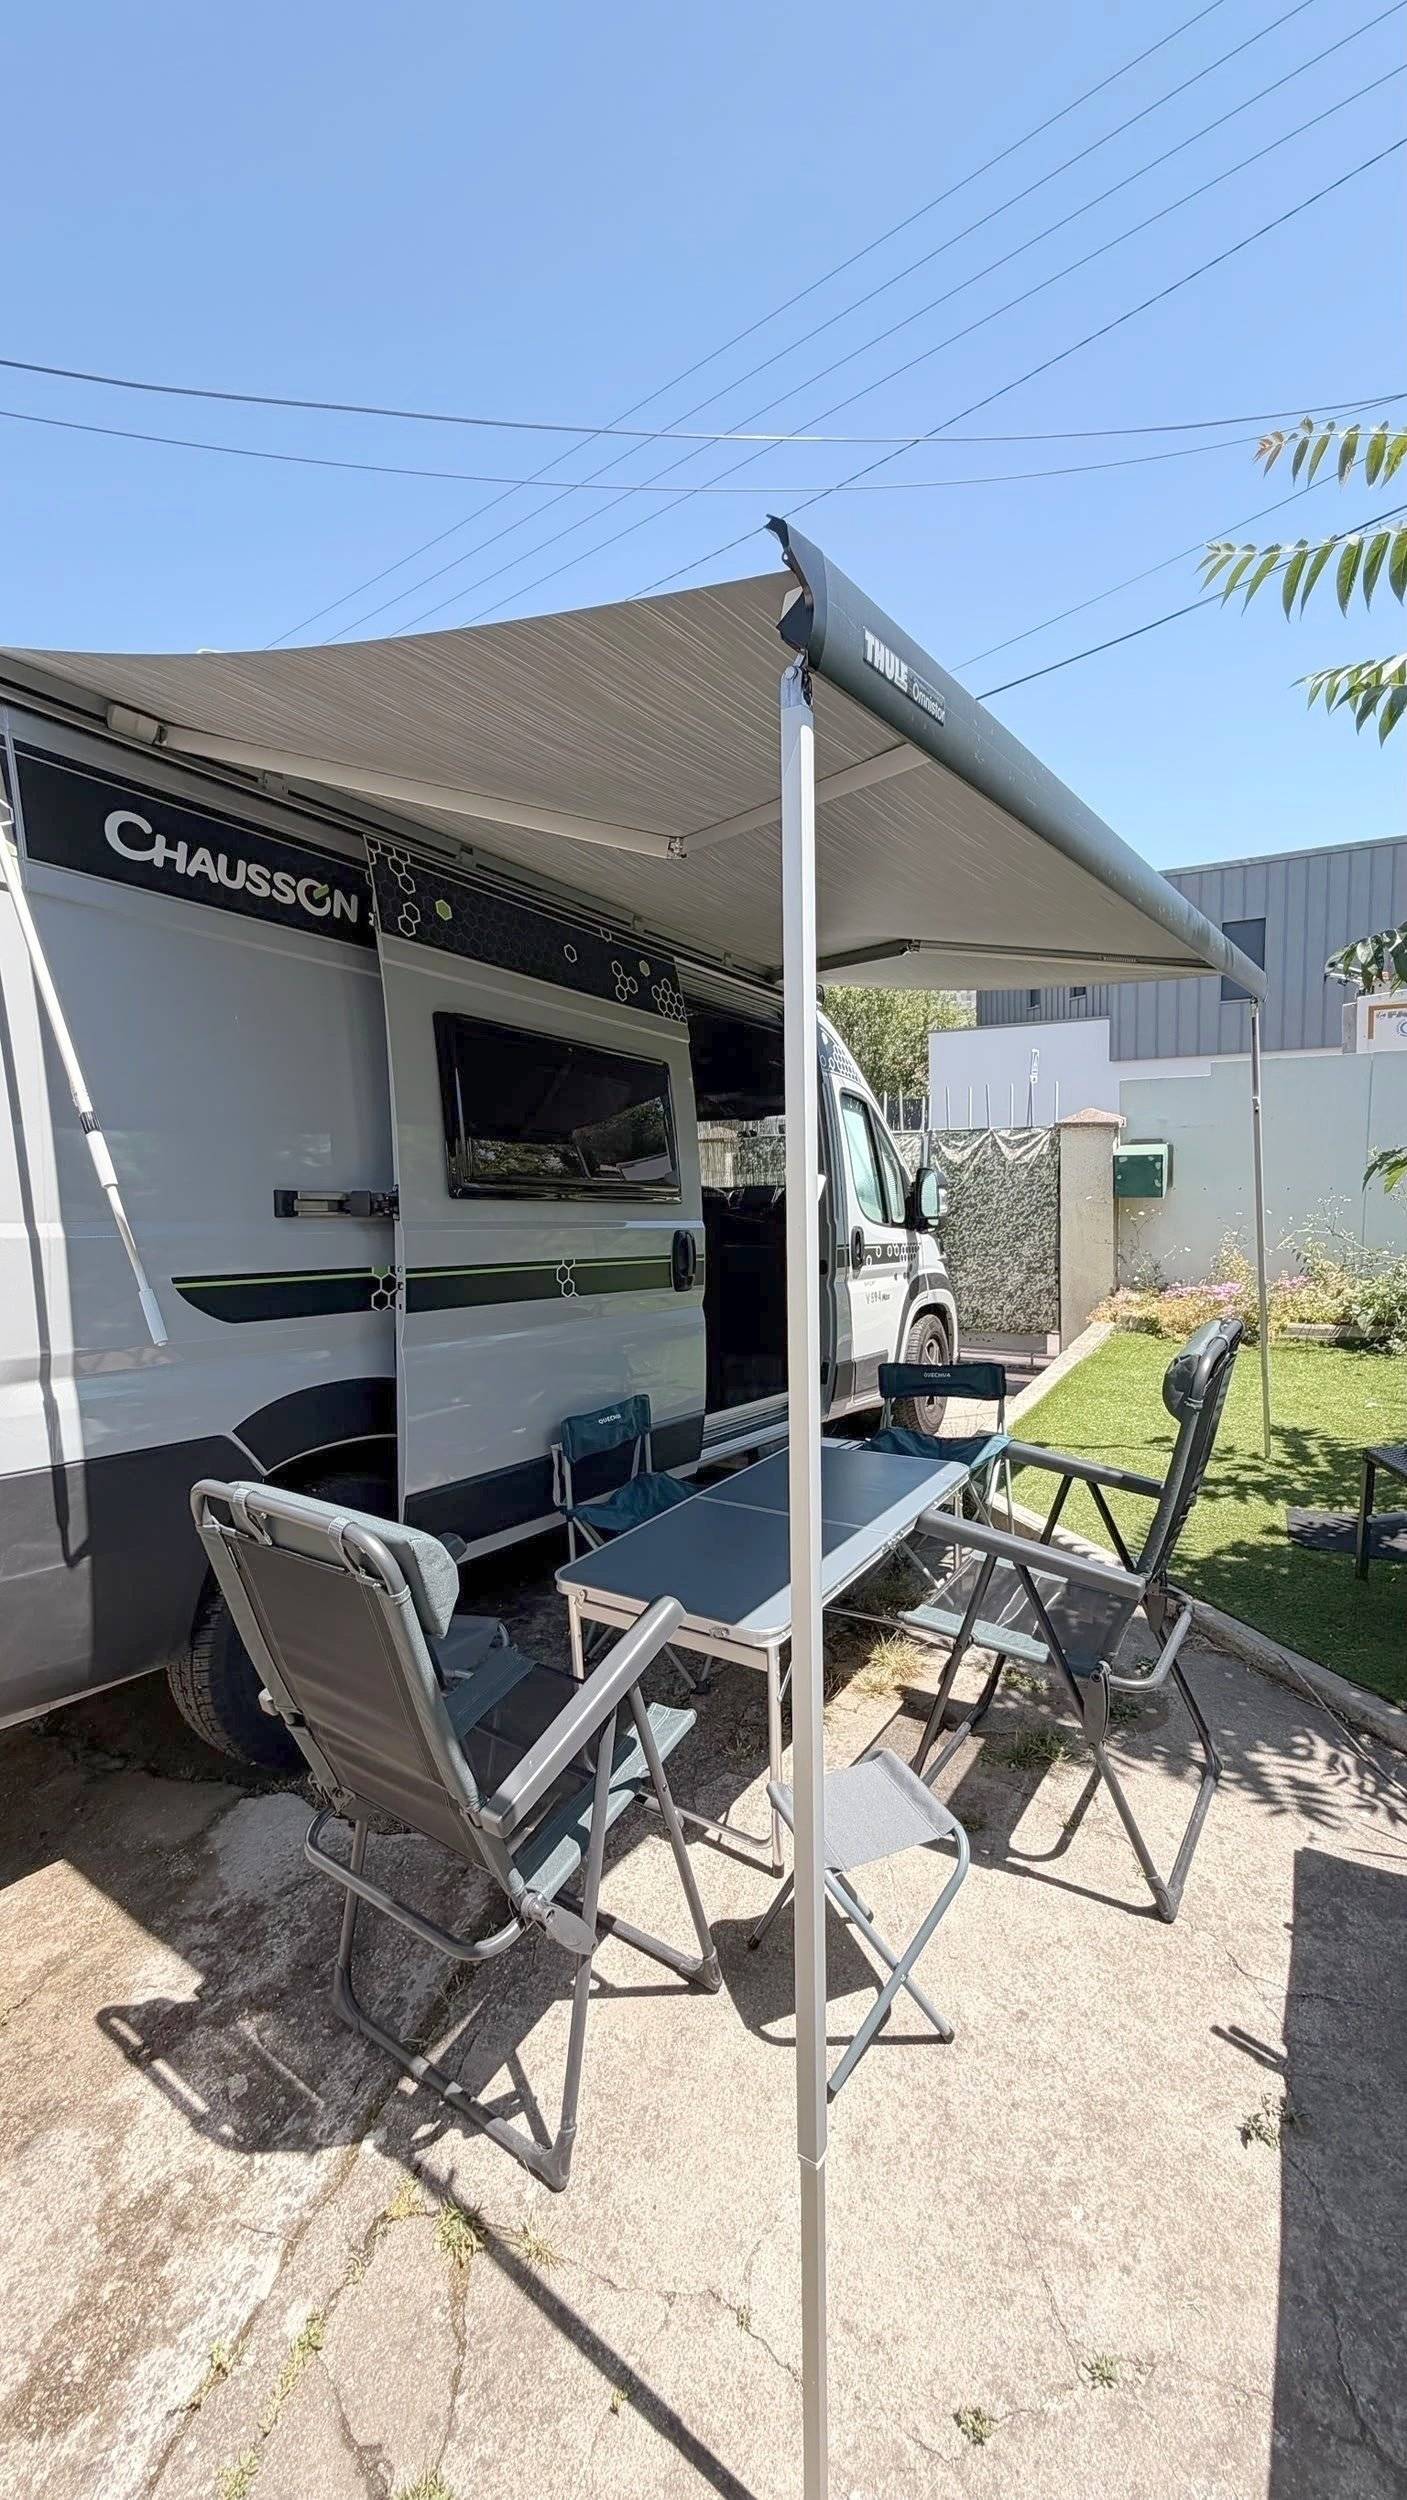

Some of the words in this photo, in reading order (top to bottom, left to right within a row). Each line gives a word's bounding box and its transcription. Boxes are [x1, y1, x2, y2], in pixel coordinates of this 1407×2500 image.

[865, 629, 908, 692] THULE
[913, 682, 945, 723] Omnistor
[104, 810, 358, 923] CHAUSSON
